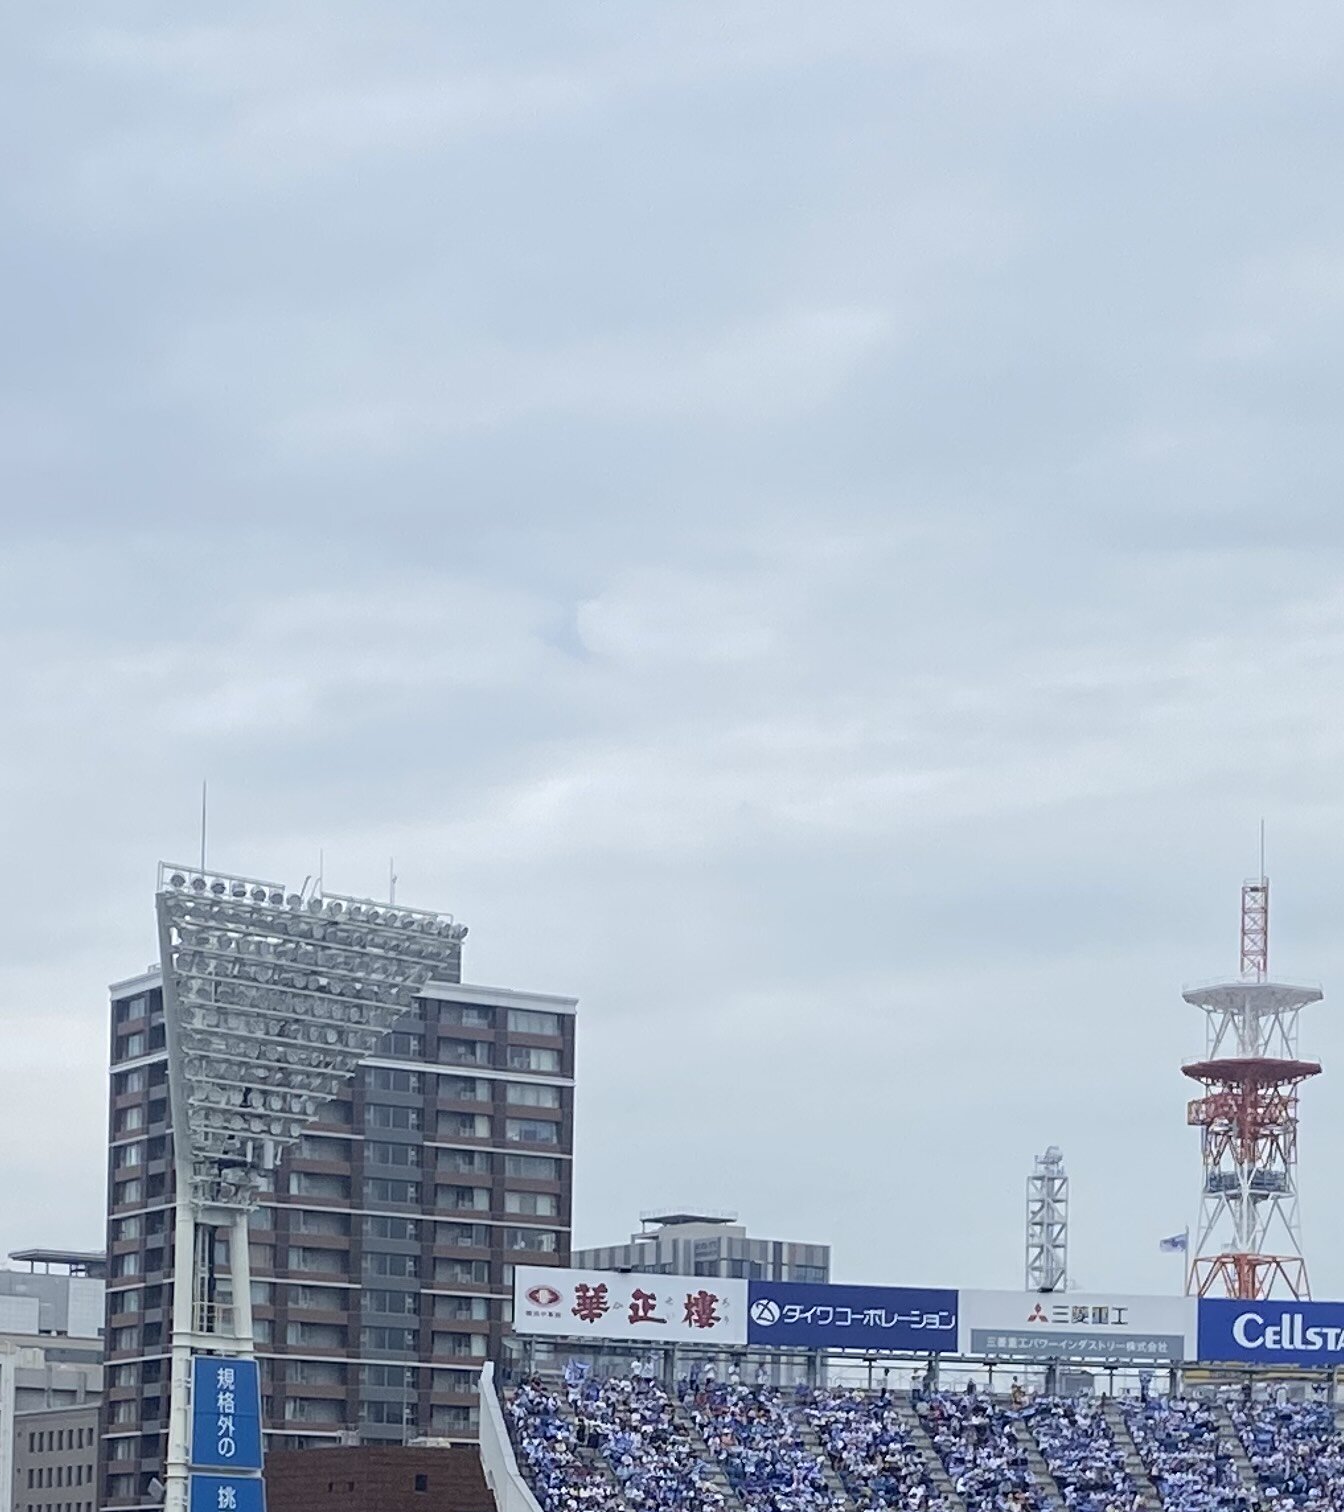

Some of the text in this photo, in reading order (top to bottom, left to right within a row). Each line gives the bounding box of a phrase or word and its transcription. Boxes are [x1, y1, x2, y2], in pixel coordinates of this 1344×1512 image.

[782, 1304, 956, 1330] ダイワコーポレーション
[1051, 1305, 1129, 1326] 三菱重工
[217, 1367, 236, 1458] 規格外の
